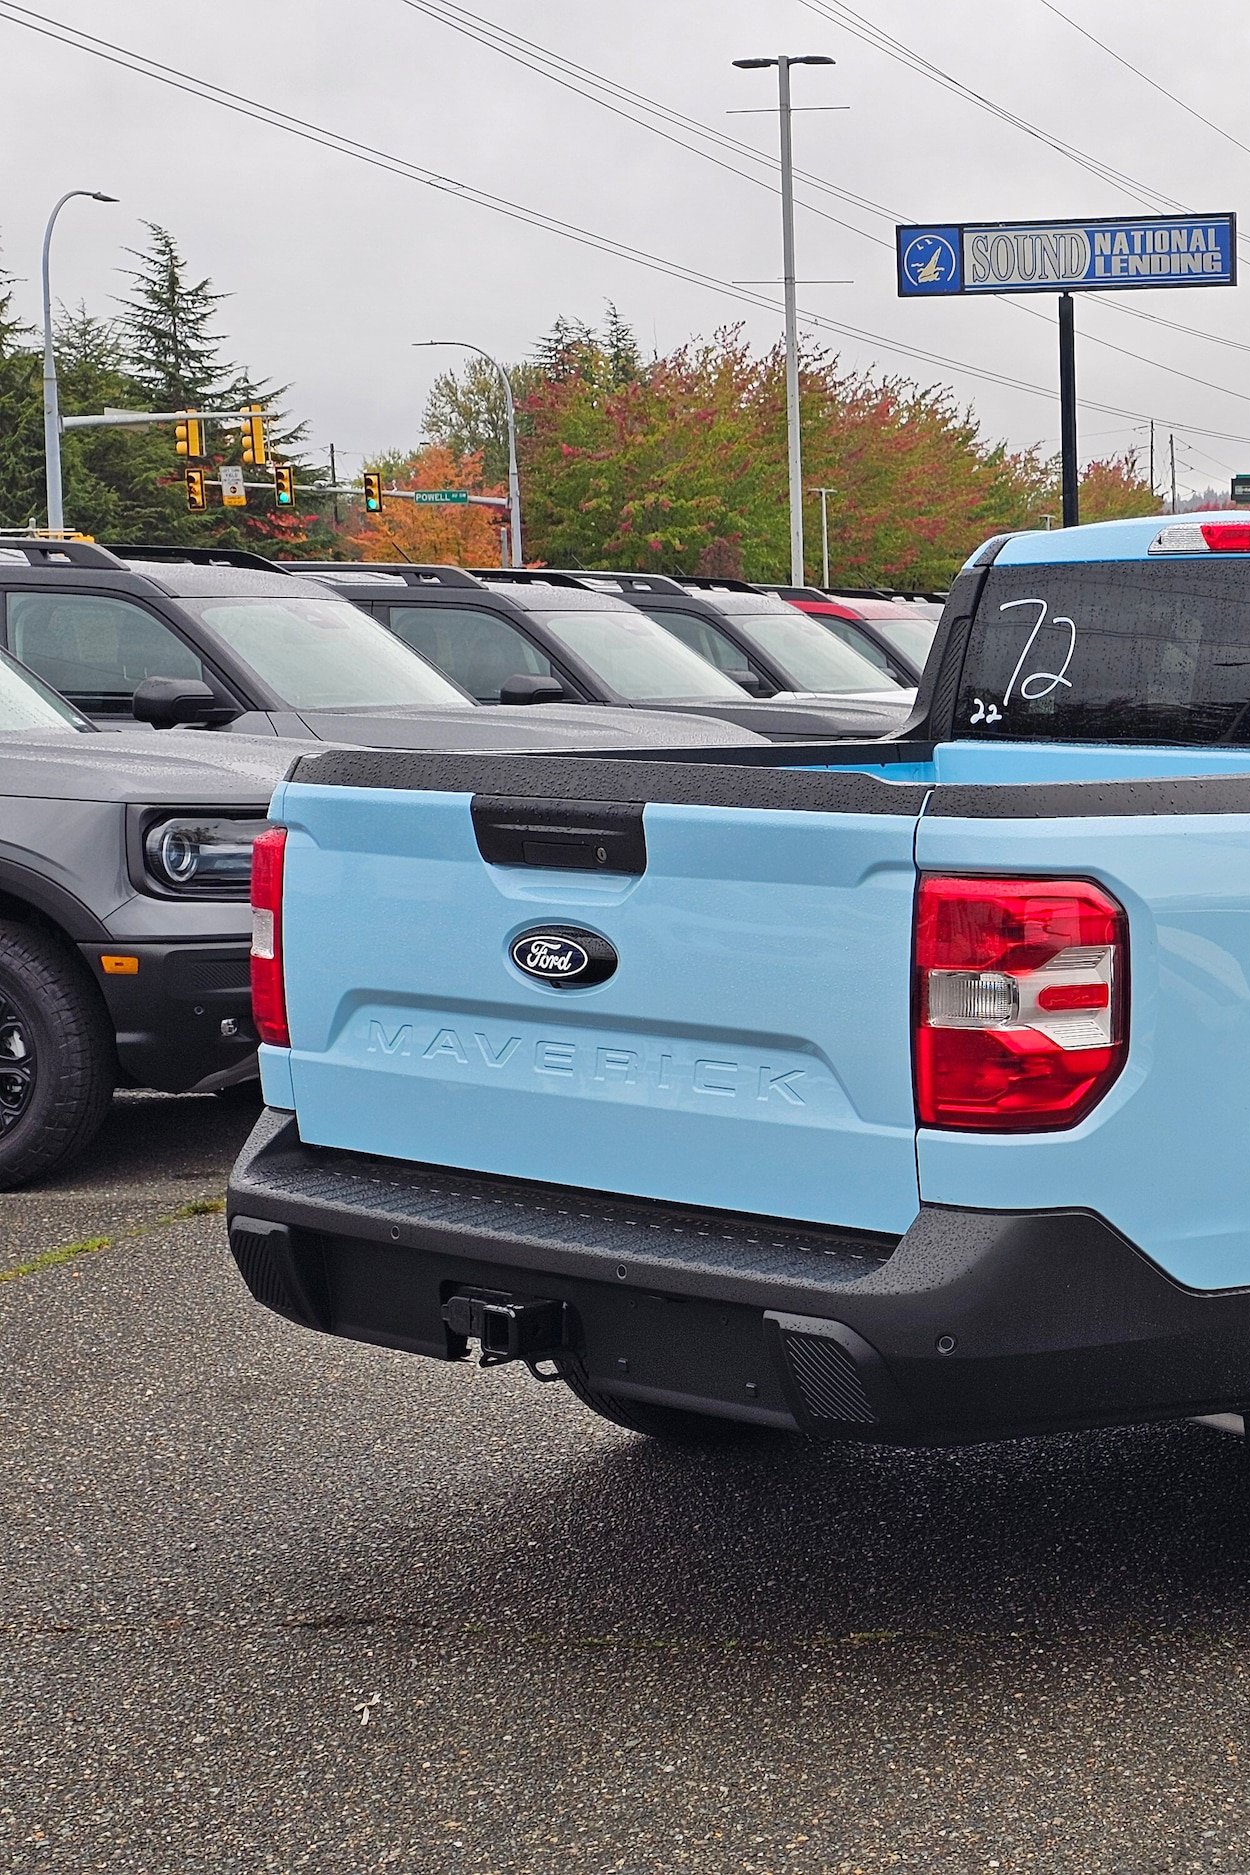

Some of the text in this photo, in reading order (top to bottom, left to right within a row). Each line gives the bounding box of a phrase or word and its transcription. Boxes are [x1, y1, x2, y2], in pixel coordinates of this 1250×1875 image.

[1095, 228, 1221, 255] NATIONAL
[971, 231, 1088, 282] SOUND
[1095, 252, 1222, 278] LENDING
[415, 493, 450, 502] POWELL
[1000, 598, 1076, 706] 72
[970, 698, 1002, 724] 22
[526, 941, 573, 971] Ford
[366, 1020, 808, 1106] MAVERICK
